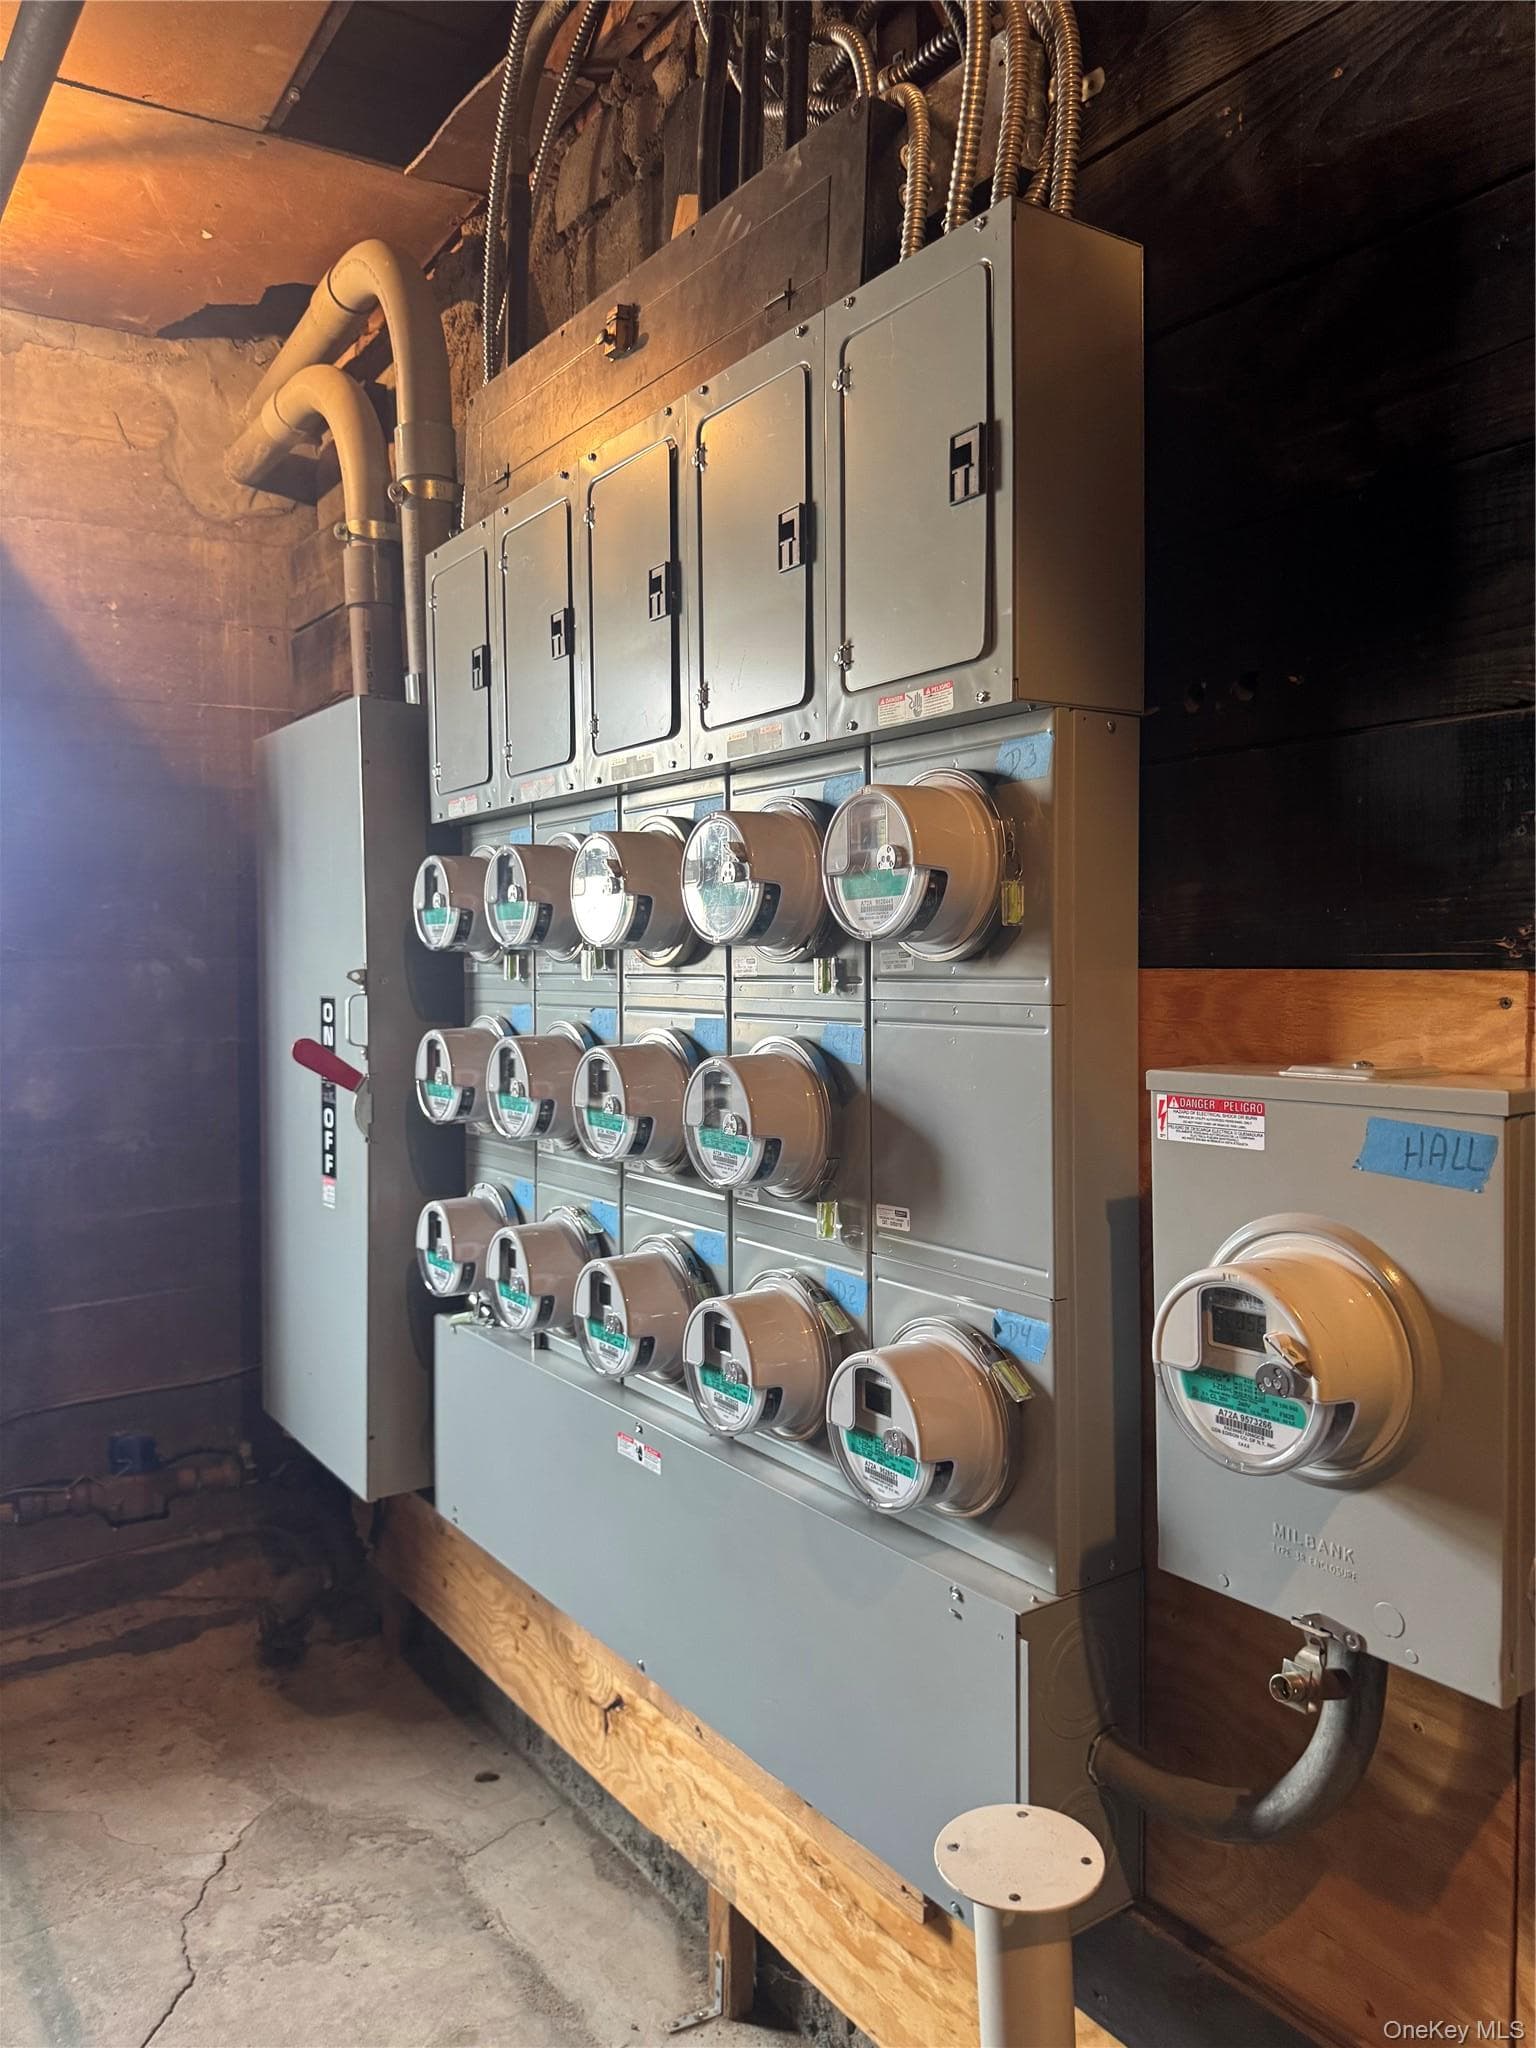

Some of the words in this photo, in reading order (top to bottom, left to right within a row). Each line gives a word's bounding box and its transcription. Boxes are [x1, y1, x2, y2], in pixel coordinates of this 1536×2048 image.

[1004, 743, 1037, 776] D3
[322, 1002, 334, 1047] ON
[1180, 1097, 1216, 1110] DANGER
[1223, 1101, 1263, 1114] PELIGRO
[322, 1107, 334, 1174] OFF
[1404, 1131, 1485, 1172] HALL
[832, 1279, 857, 1305] D2
[1002, 1320, 1032, 1348] D4
[1218, 1408, 1239, 1421] A72A
[1272, 1521, 1356, 1565] MILBANK
